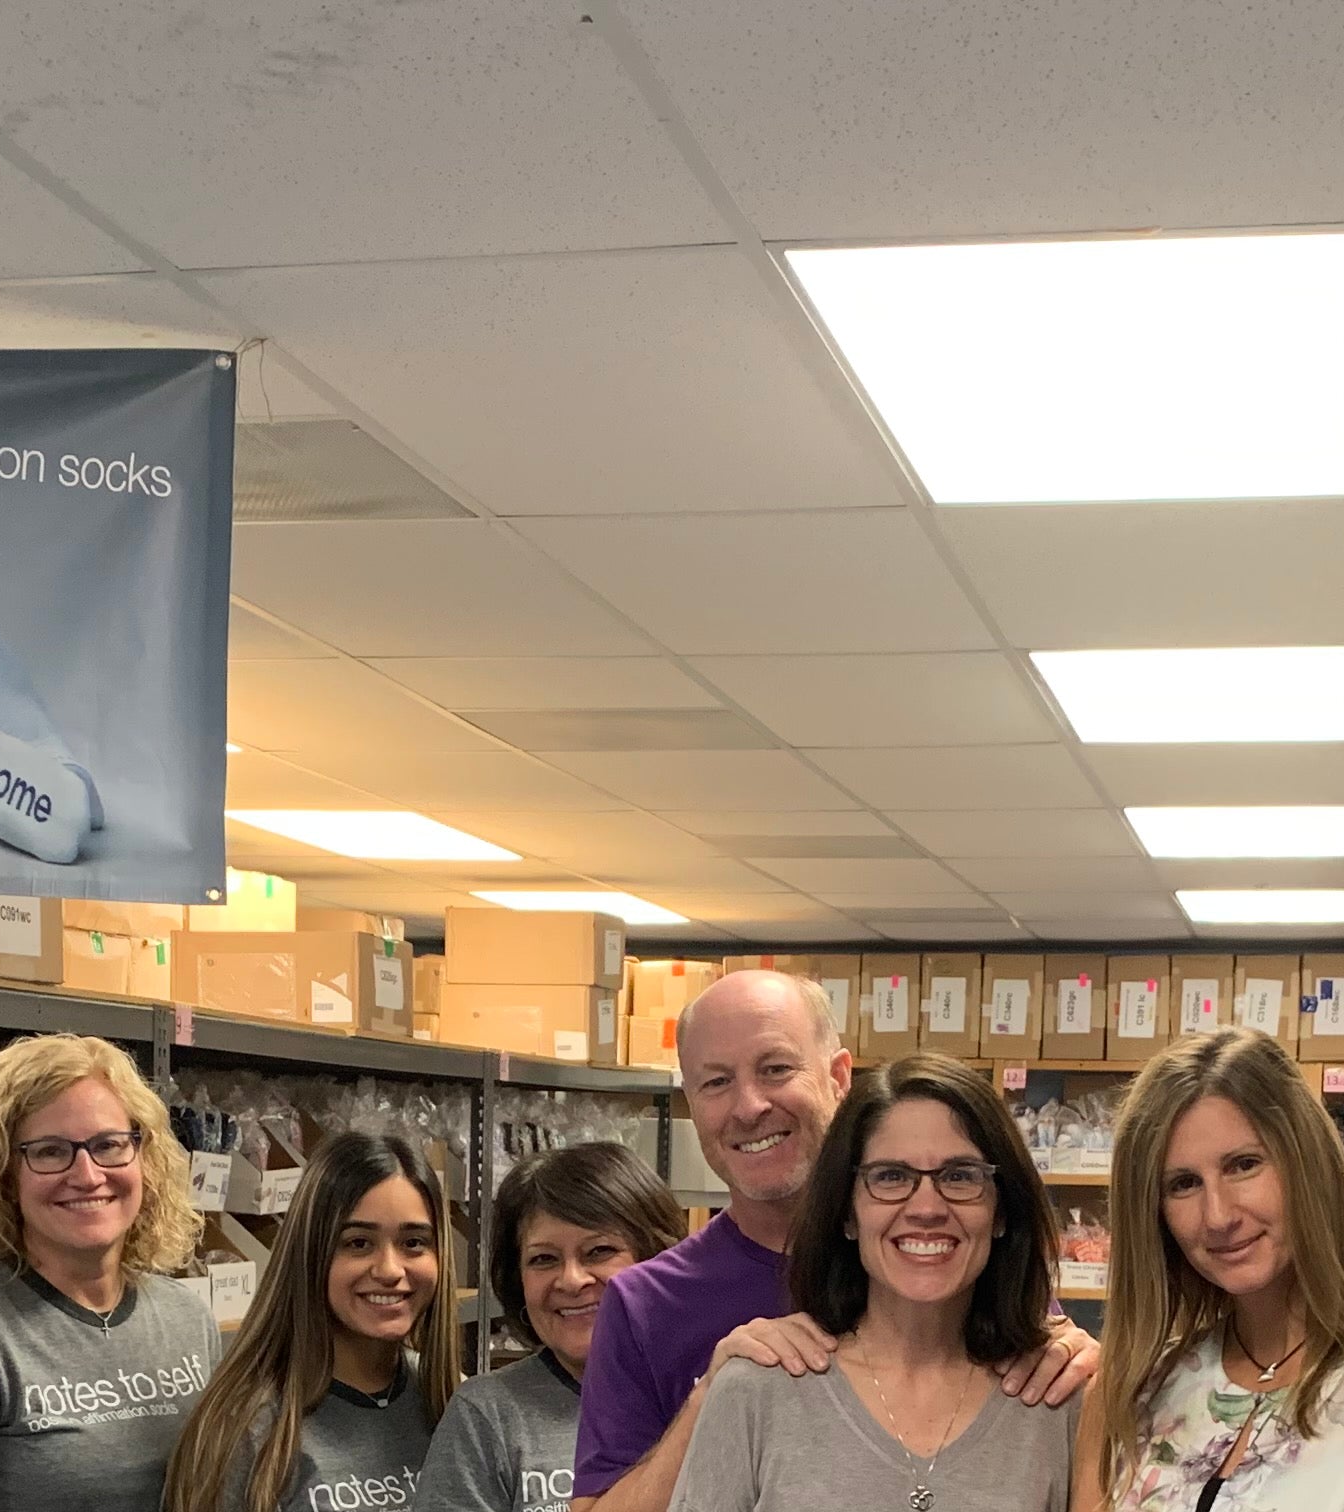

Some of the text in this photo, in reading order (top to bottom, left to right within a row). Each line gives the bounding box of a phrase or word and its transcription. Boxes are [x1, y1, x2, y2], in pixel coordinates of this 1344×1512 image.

[57, 453, 172, 497] socks
[0, 905, 31, 924] C091wc
[25, 1354, 208, 1417] notes to self
[82, 1405, 150, 1425] affirmation
